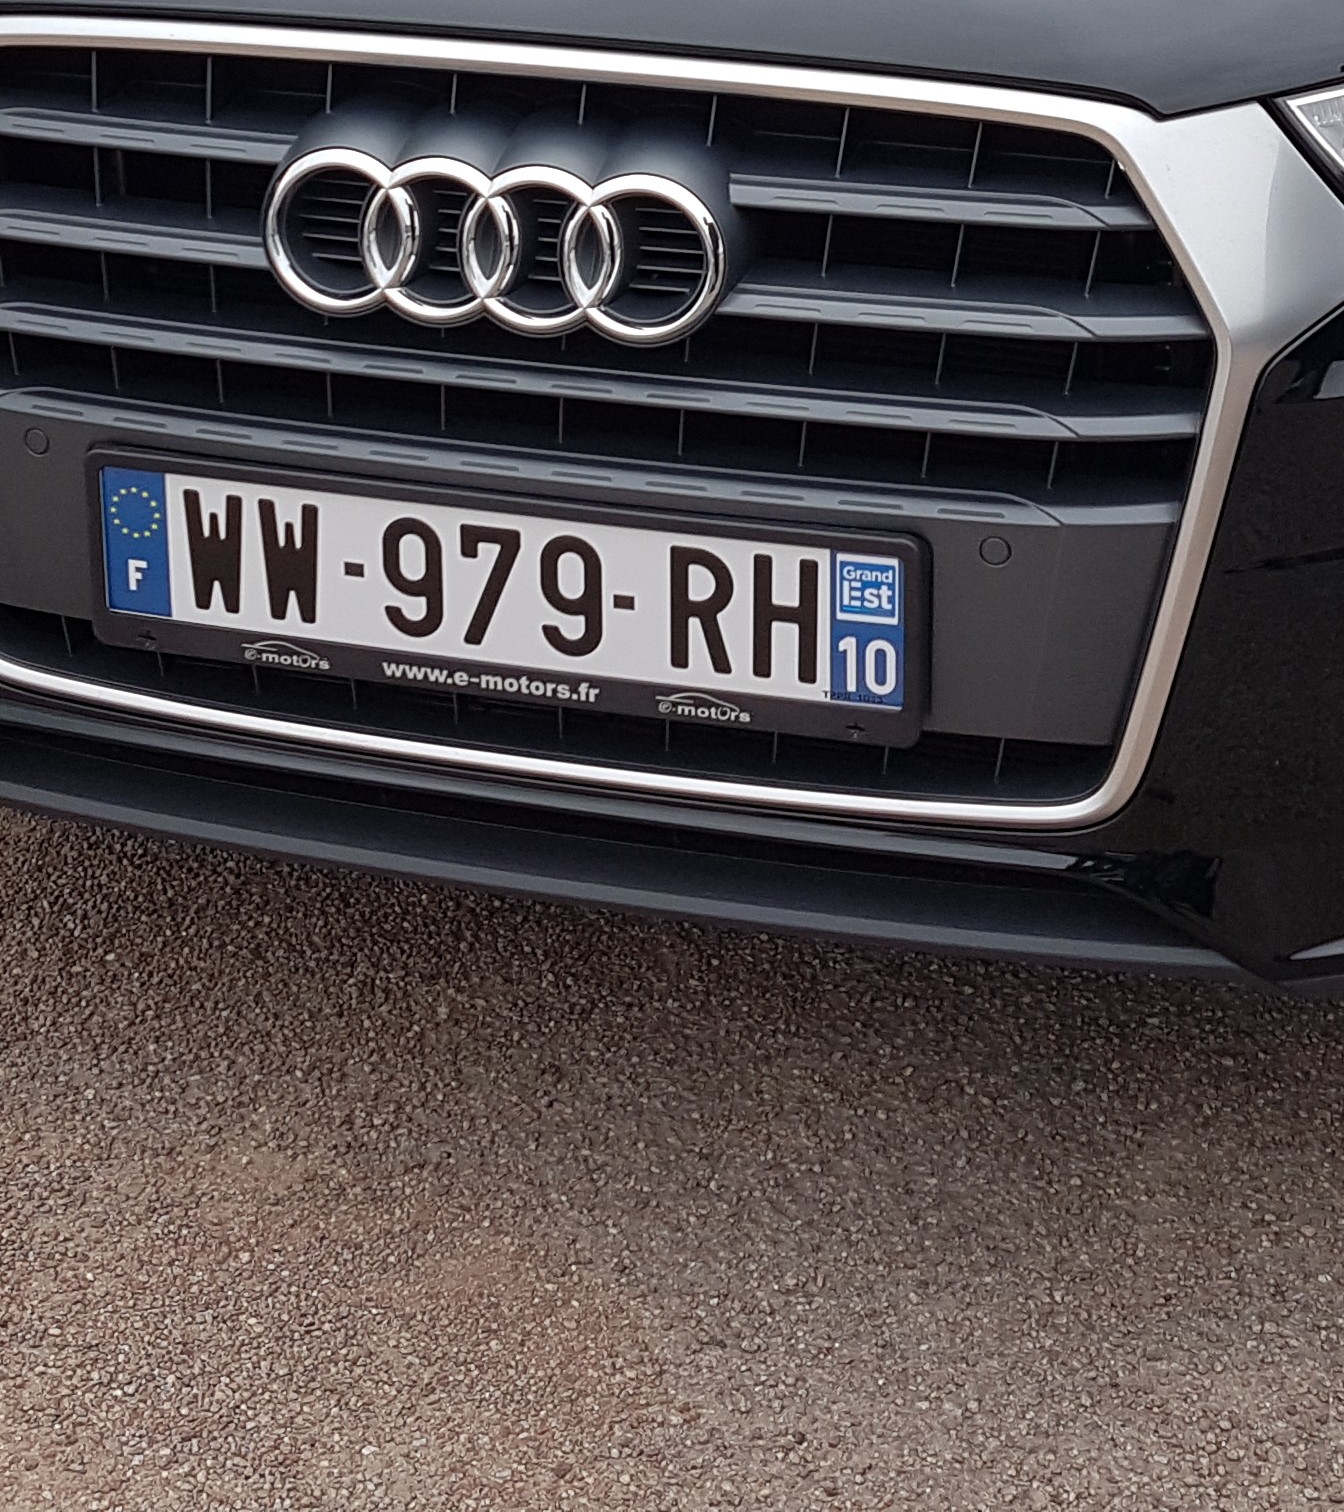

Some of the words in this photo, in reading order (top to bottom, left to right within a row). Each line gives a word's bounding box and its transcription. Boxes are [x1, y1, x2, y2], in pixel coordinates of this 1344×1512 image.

[127, 558, 148, 591] F
[842, 565, 893, 584] Grand
[842, 580, 893, 610] Est
[382, 661, 600, 703] www.e-motors.fr
[838, 635, 897, 696] 10
